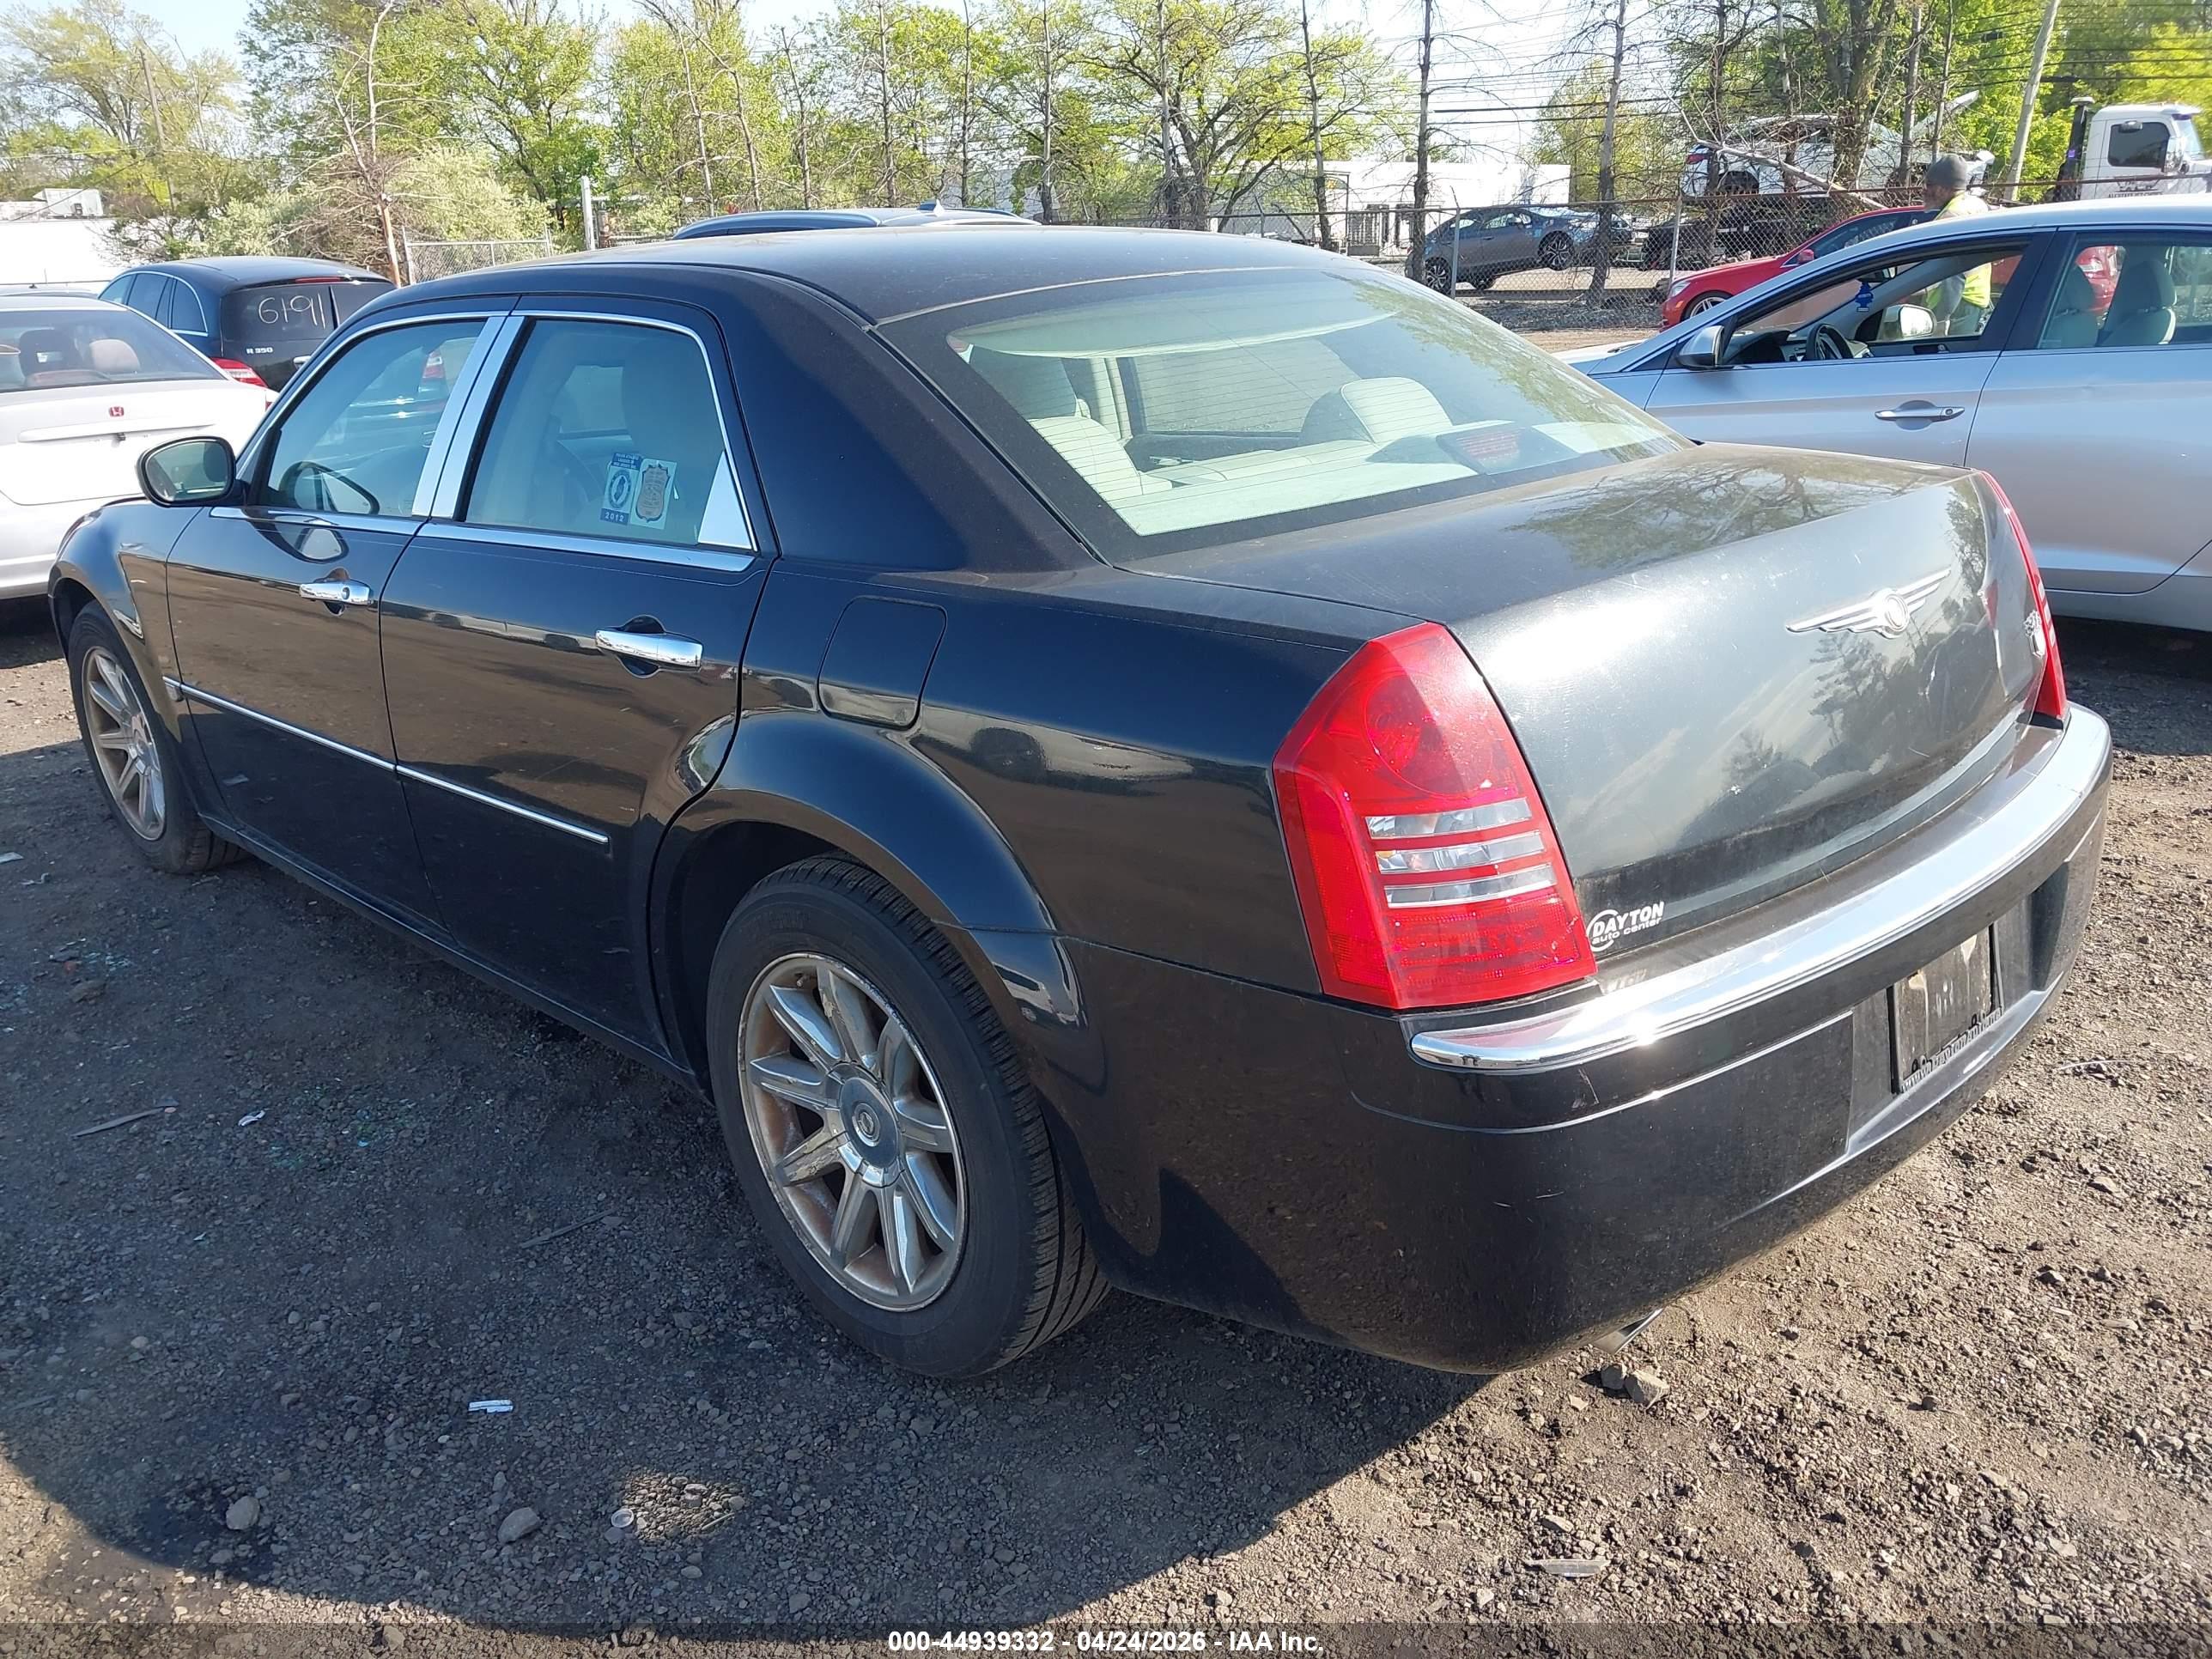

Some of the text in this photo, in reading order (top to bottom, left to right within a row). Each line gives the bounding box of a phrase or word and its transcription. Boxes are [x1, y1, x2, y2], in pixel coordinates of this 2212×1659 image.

[258, 293, 325, 329] 6191
[605, 512, 624, 522] 2012
[1591, 917, 1662, 945] auto center
[1593, 901, 1664, 938] DAYTON
